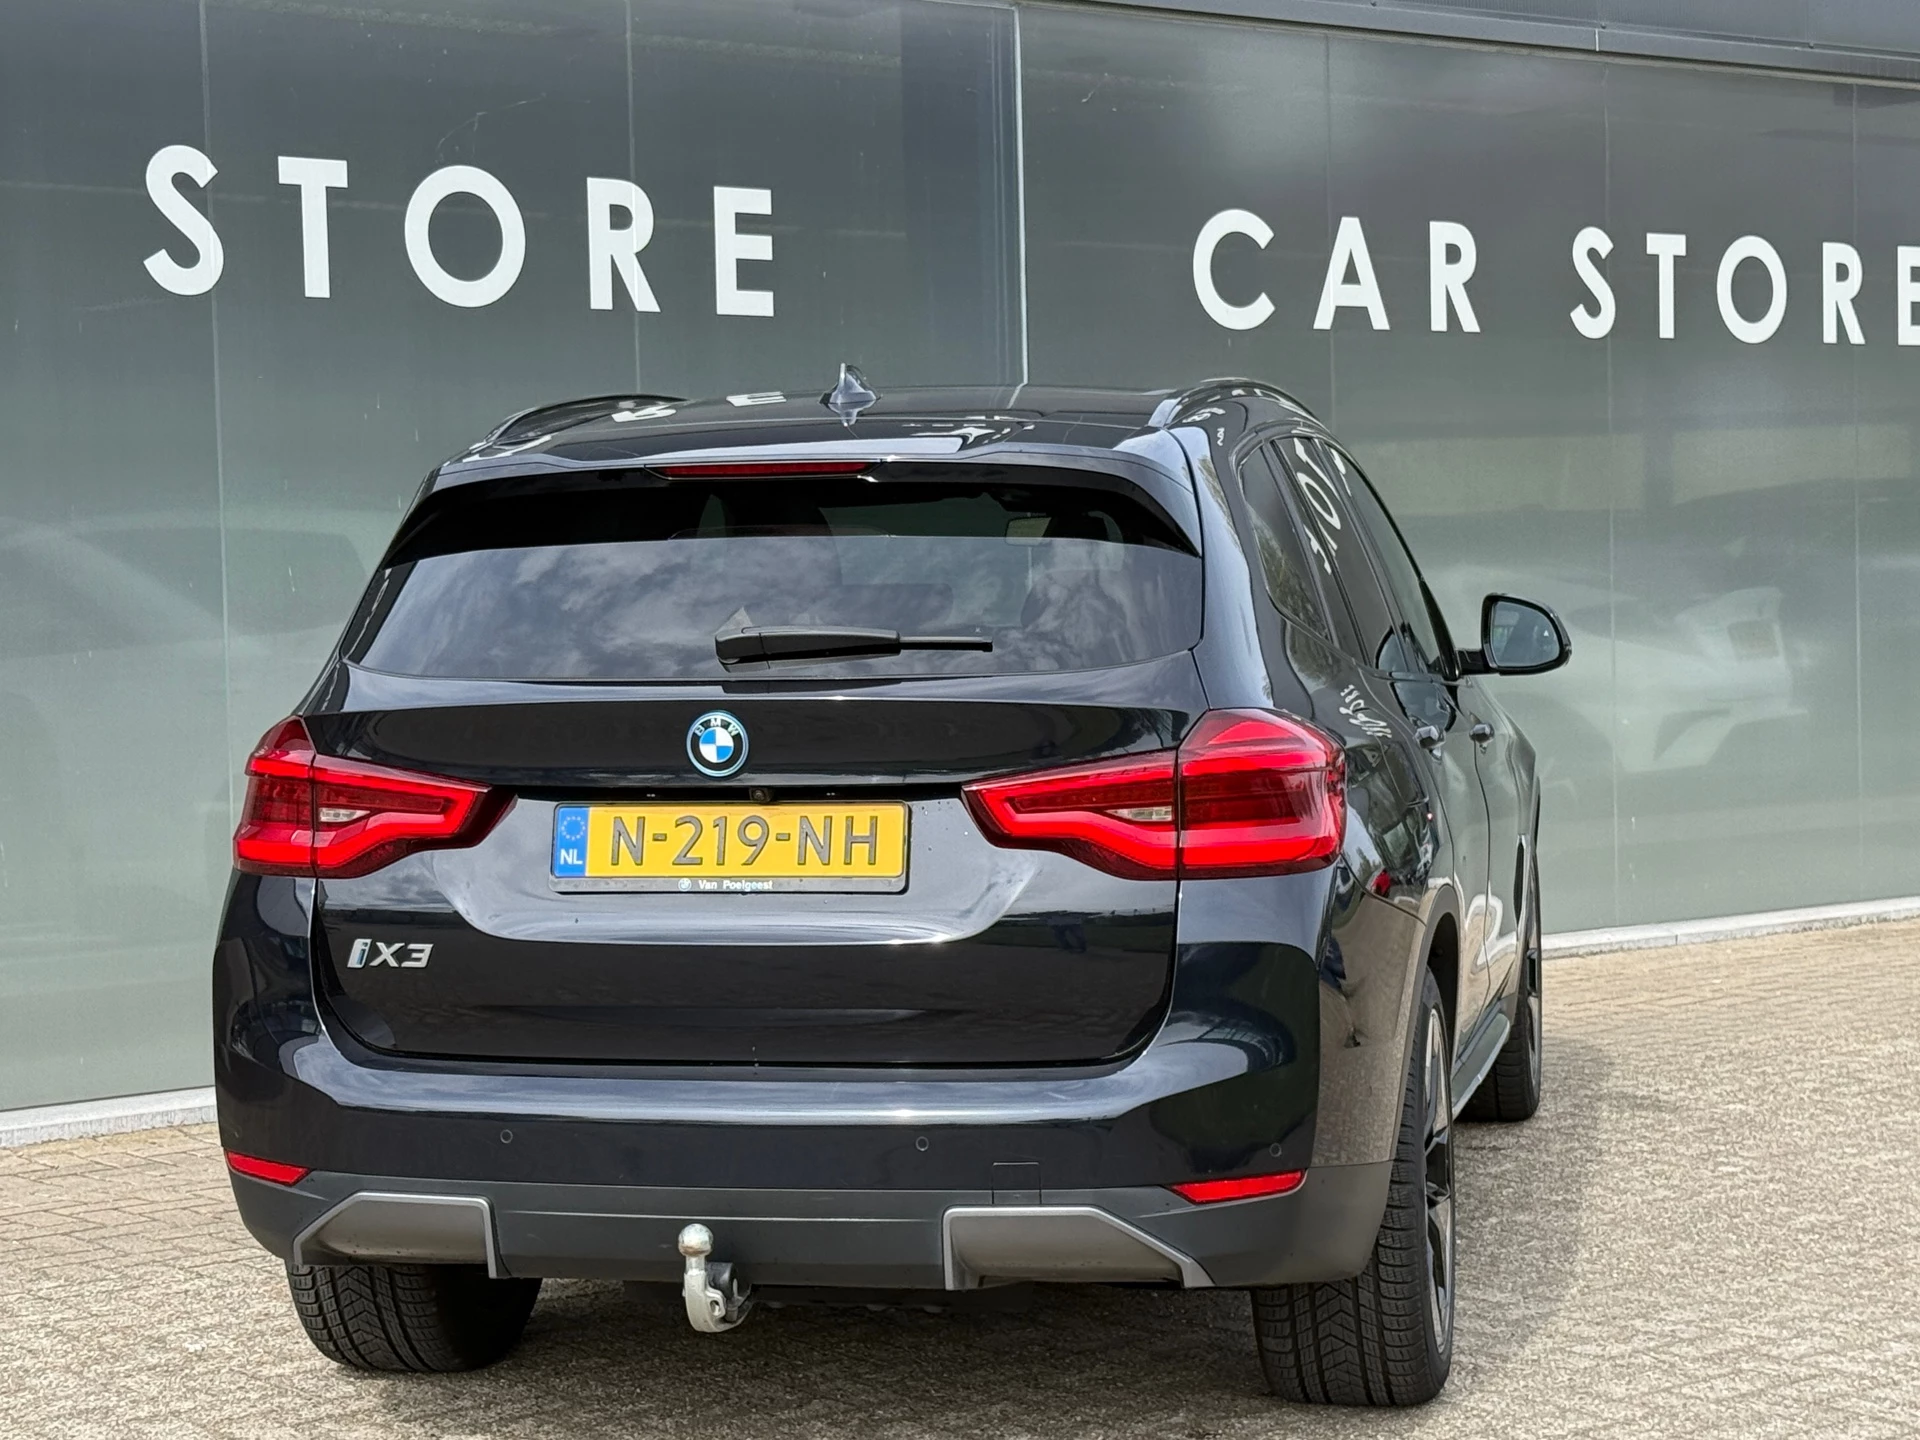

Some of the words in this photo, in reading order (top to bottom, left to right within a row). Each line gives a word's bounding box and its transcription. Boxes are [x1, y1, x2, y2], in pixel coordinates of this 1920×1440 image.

[143, 144, 775, 317] STORE
[1192, 208, 1482, 333] CAR
[1570, 226, 1920, 346] STORE
[559, 848, 584, 865] NL
[609, 814, 879, 867] N-219-NH
[698, 879, 718, 890] Van
[723, 879, 774, 892] Poelgeest
